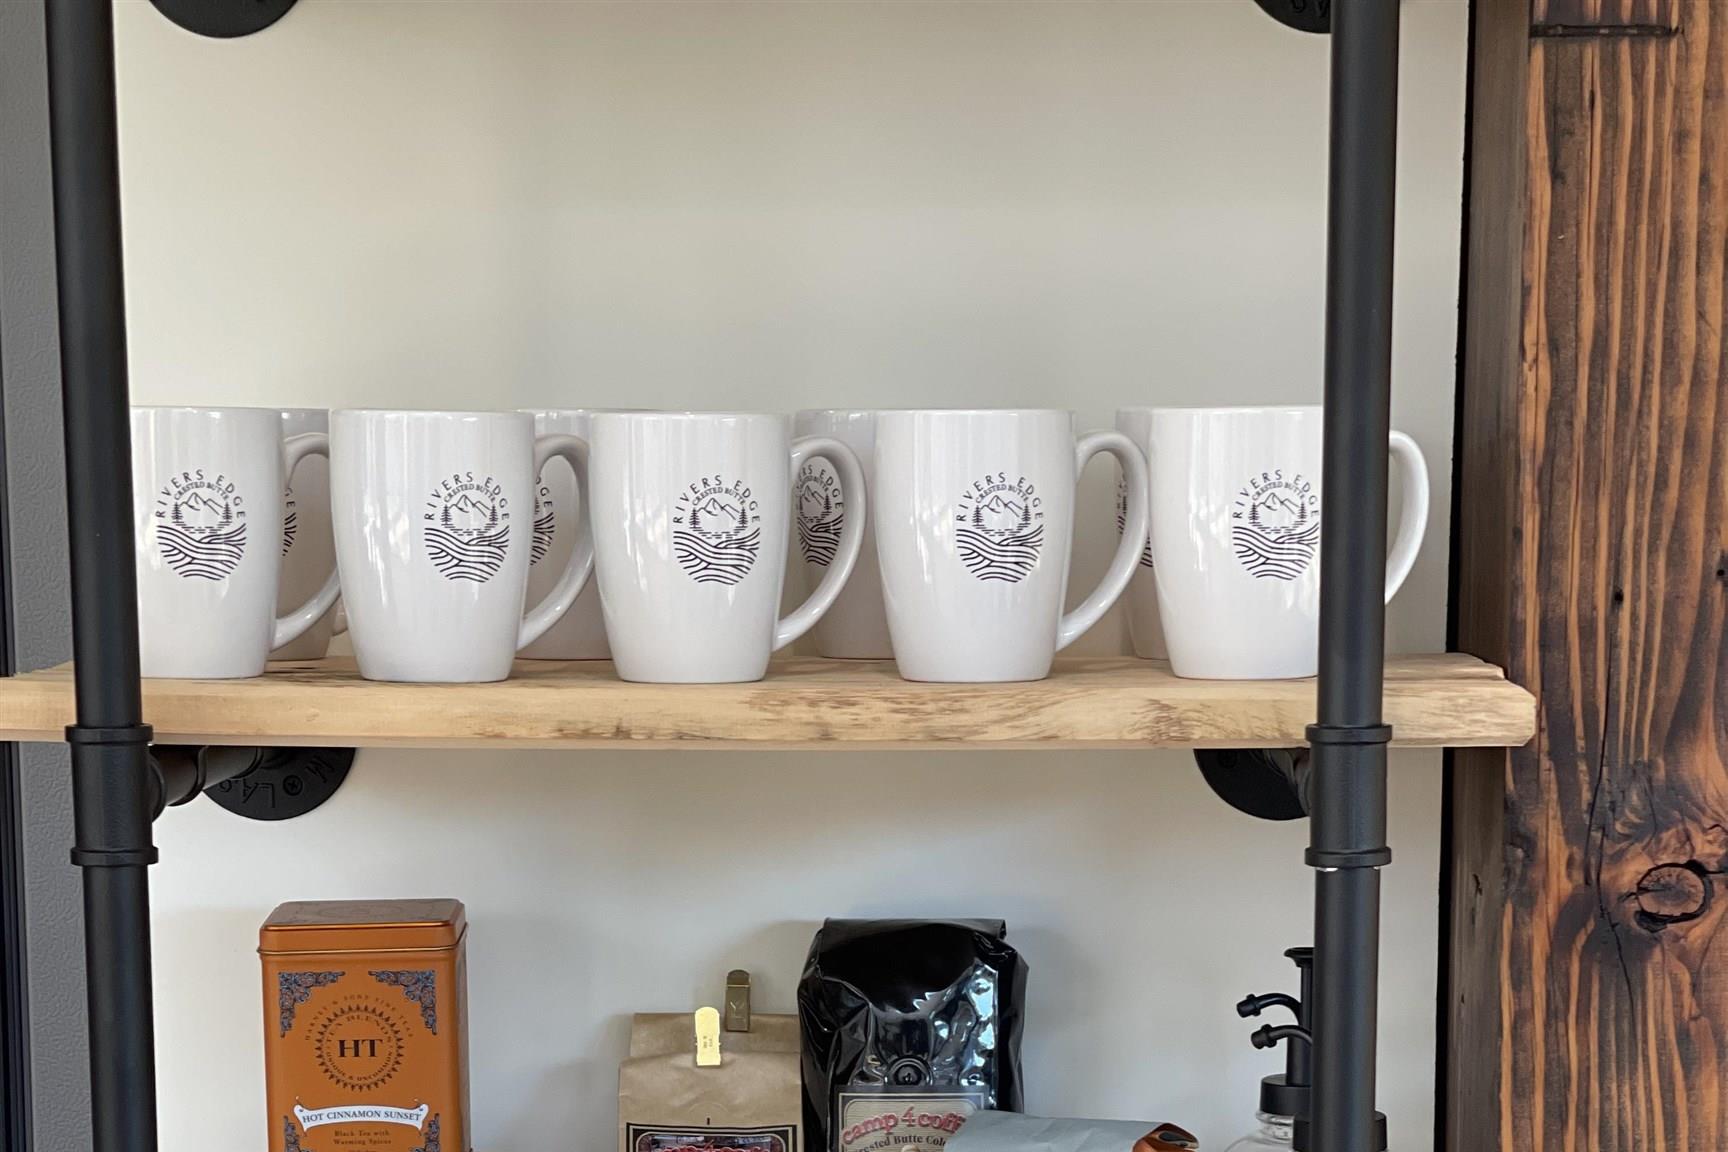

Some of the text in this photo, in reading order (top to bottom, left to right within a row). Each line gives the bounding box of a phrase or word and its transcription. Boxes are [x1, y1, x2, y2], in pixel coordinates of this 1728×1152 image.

[156, 469, 246, 519] RIVERS EDGE
[425, 472, 509, 520] RIVERS EDGE
[673, 475, 760, 524] RIVERS EDGE
[956, 472, 1043, 521] RIVERS EDGE
[1232, 469, 1319, 518] RIVERS EDGE
[338, 1039, 383, 1057] HT
[302, 1110, 421, 1123] HOT CINNAMON SUNSET
[842, 1112, 899, 1146] camp
[900, 1105, 916, 1127] 4
[893, 1135, 924, 1145] Butte
